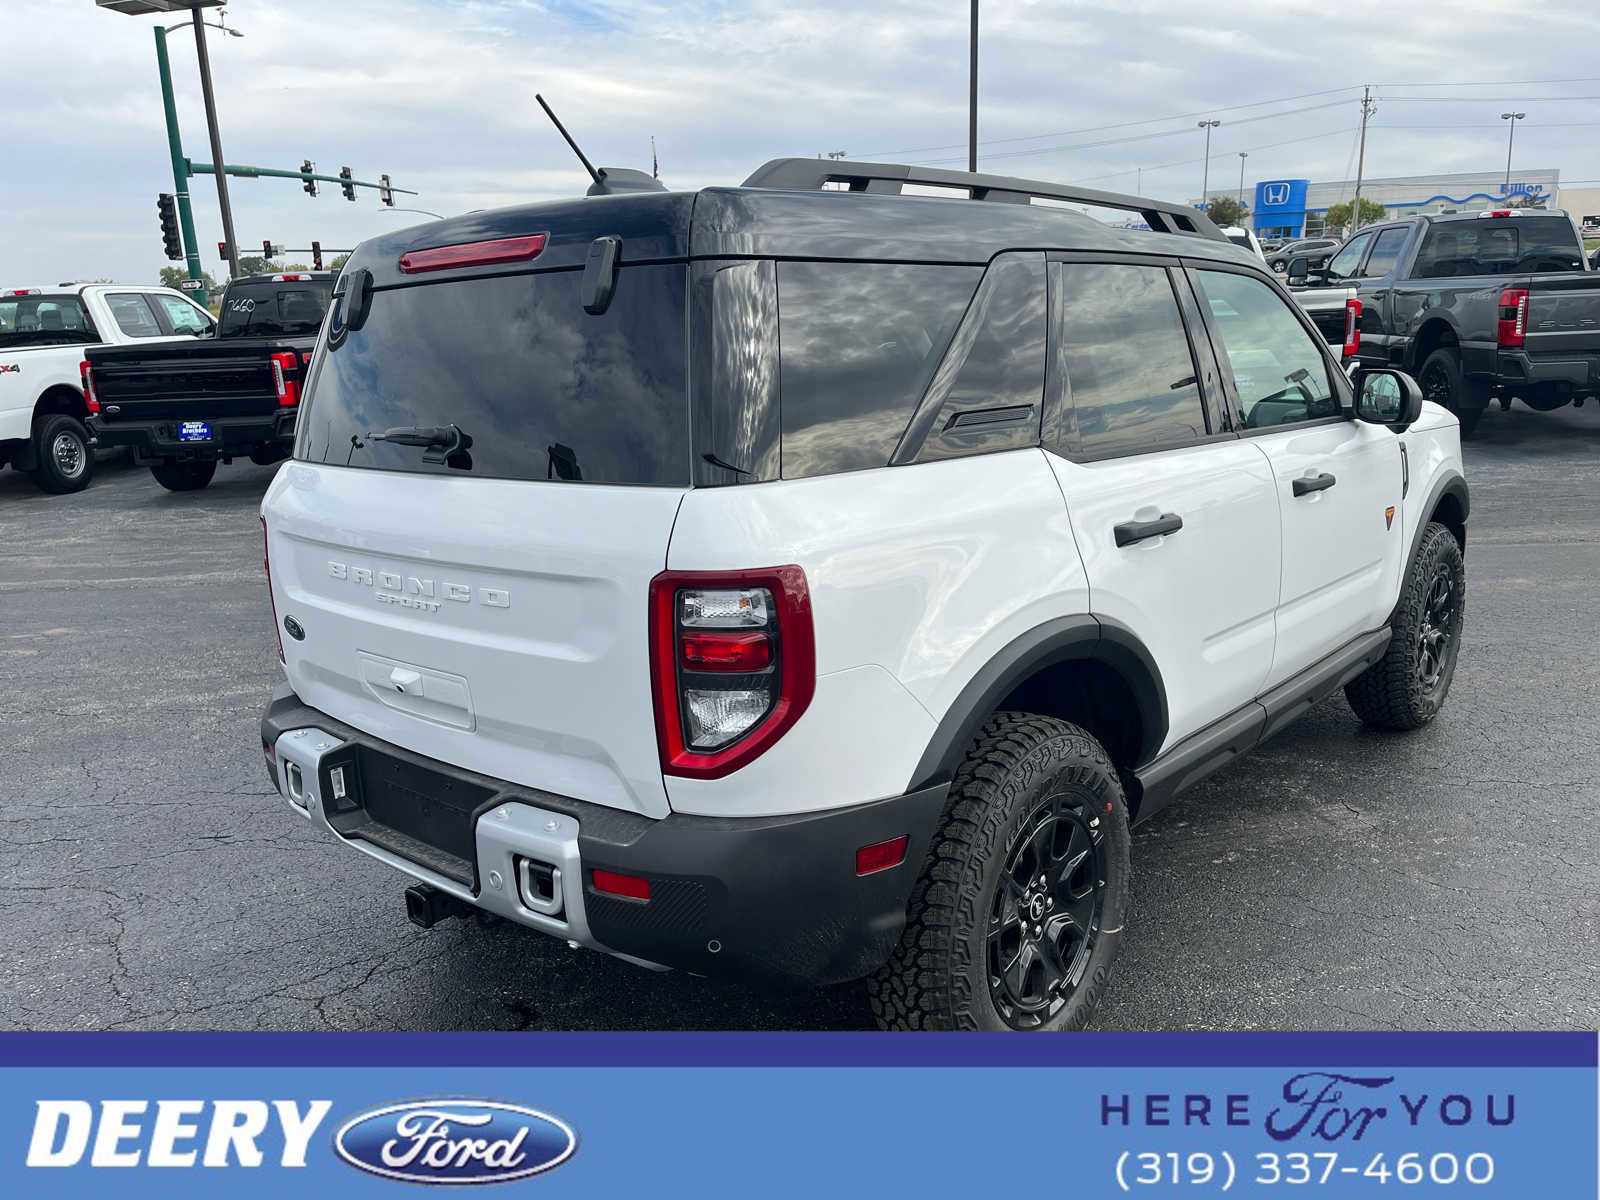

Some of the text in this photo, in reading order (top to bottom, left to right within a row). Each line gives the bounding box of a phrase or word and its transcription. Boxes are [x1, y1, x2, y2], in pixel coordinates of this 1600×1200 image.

[1501, 183, 1543, 193] Billion
[327, 561, 510, 608] BRONCO
[375, 592, 442, 612] SPORT
